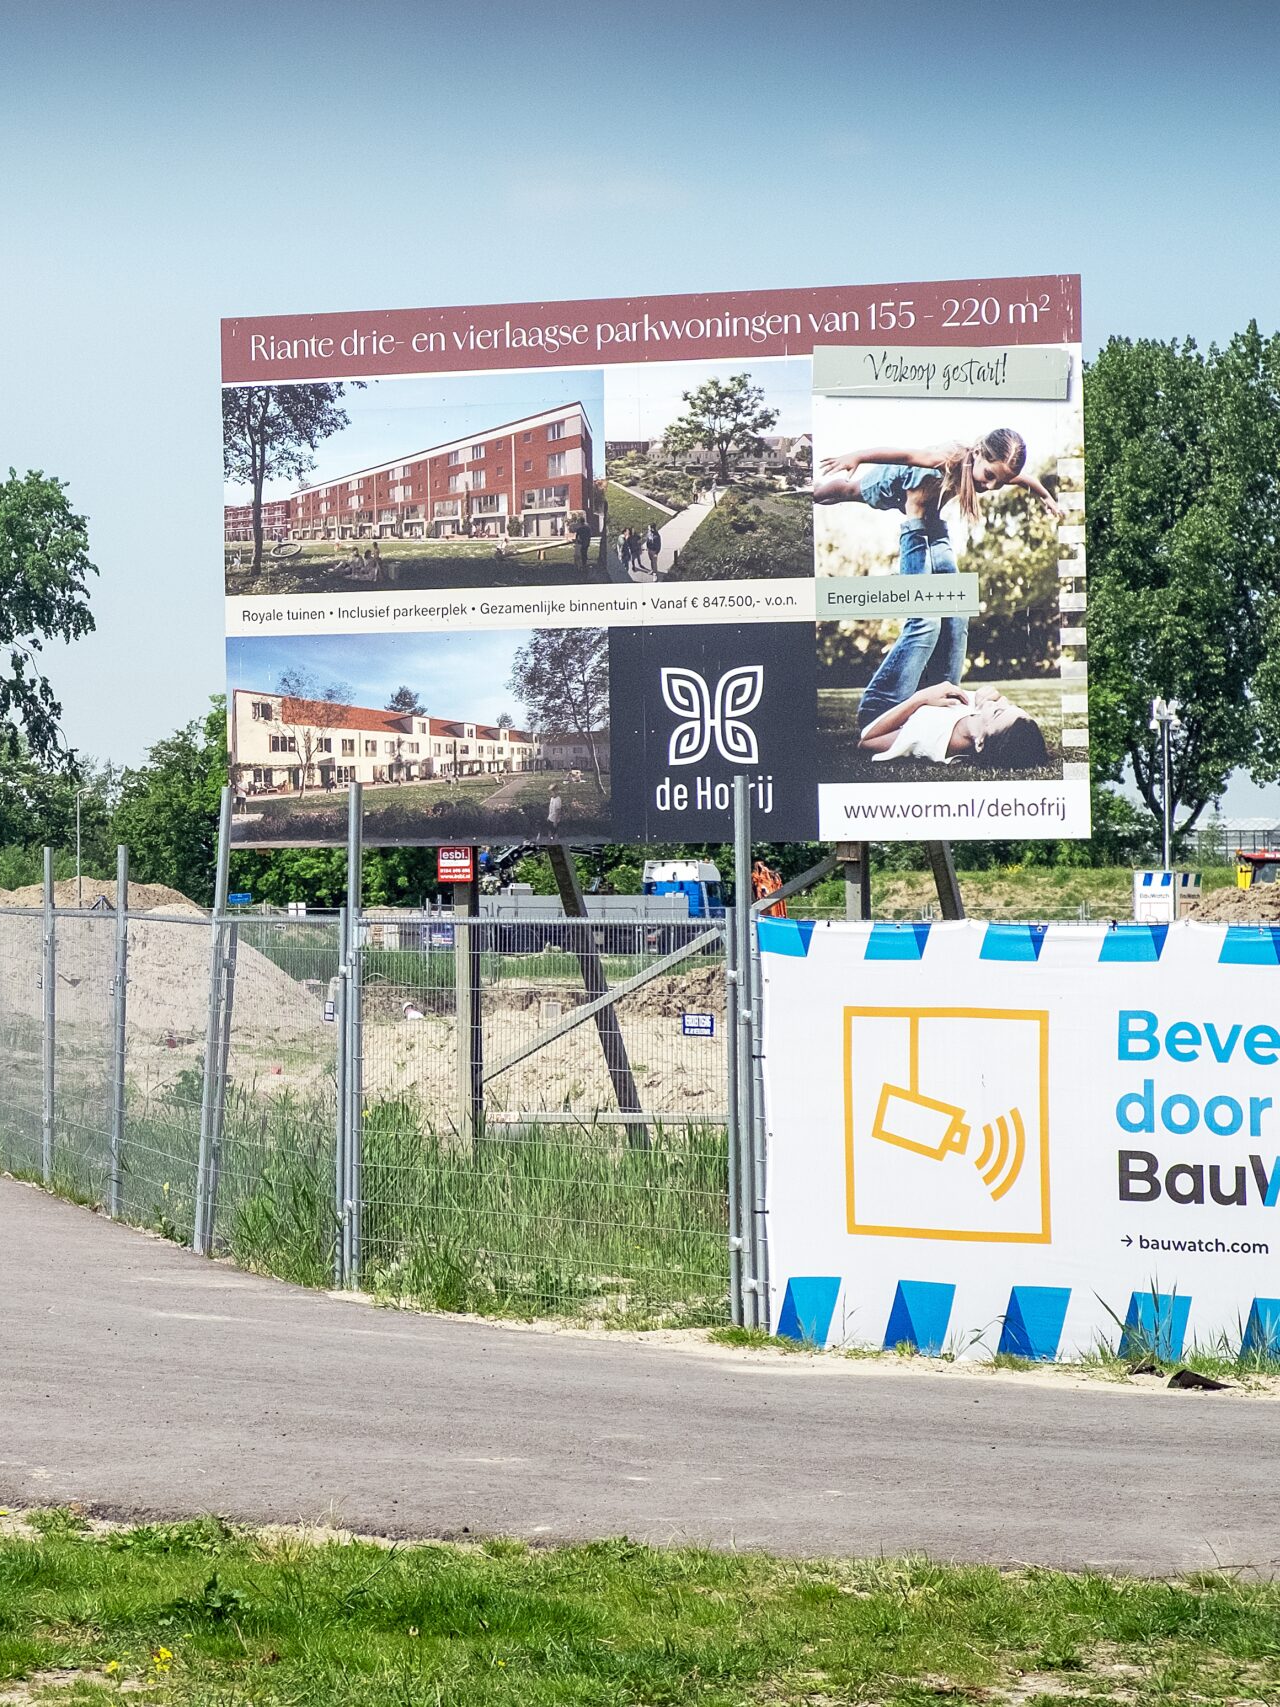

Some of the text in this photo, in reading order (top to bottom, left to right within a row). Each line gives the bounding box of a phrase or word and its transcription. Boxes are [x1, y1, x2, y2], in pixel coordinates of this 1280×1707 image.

[251, 334, 335, 361] Riante
[340, 328, 406, 356] drie-
[411, 331, 446, 353] en
[452, 320, 589, 353] vierlaagse
[596, 311, 801, 351] parkwoningen
[808, 311, 860, 333] van
[867, 301, 916, 330] 155
[941, 296, 1001, 327] 220
[1008, 293, 1051, 324] m²
[863, 350, 1008, 390] Verkoop gestart!
[242, 595, 798, 624] Royale tuinen Inclusief parkeerplek Gezamenlijke binnentuin Vanaf € 847.500,- v.o.n.
[827, 589, 967, 606] Energielabel A++++
[655, 775, 773, 814] de Horij
[843, 797, 1067, 822] www.vorm.nl/dehofrij
[1115, 1078, 1273, 1137] door
[1139, 1234, 1270, 1254] bauwatch.com
